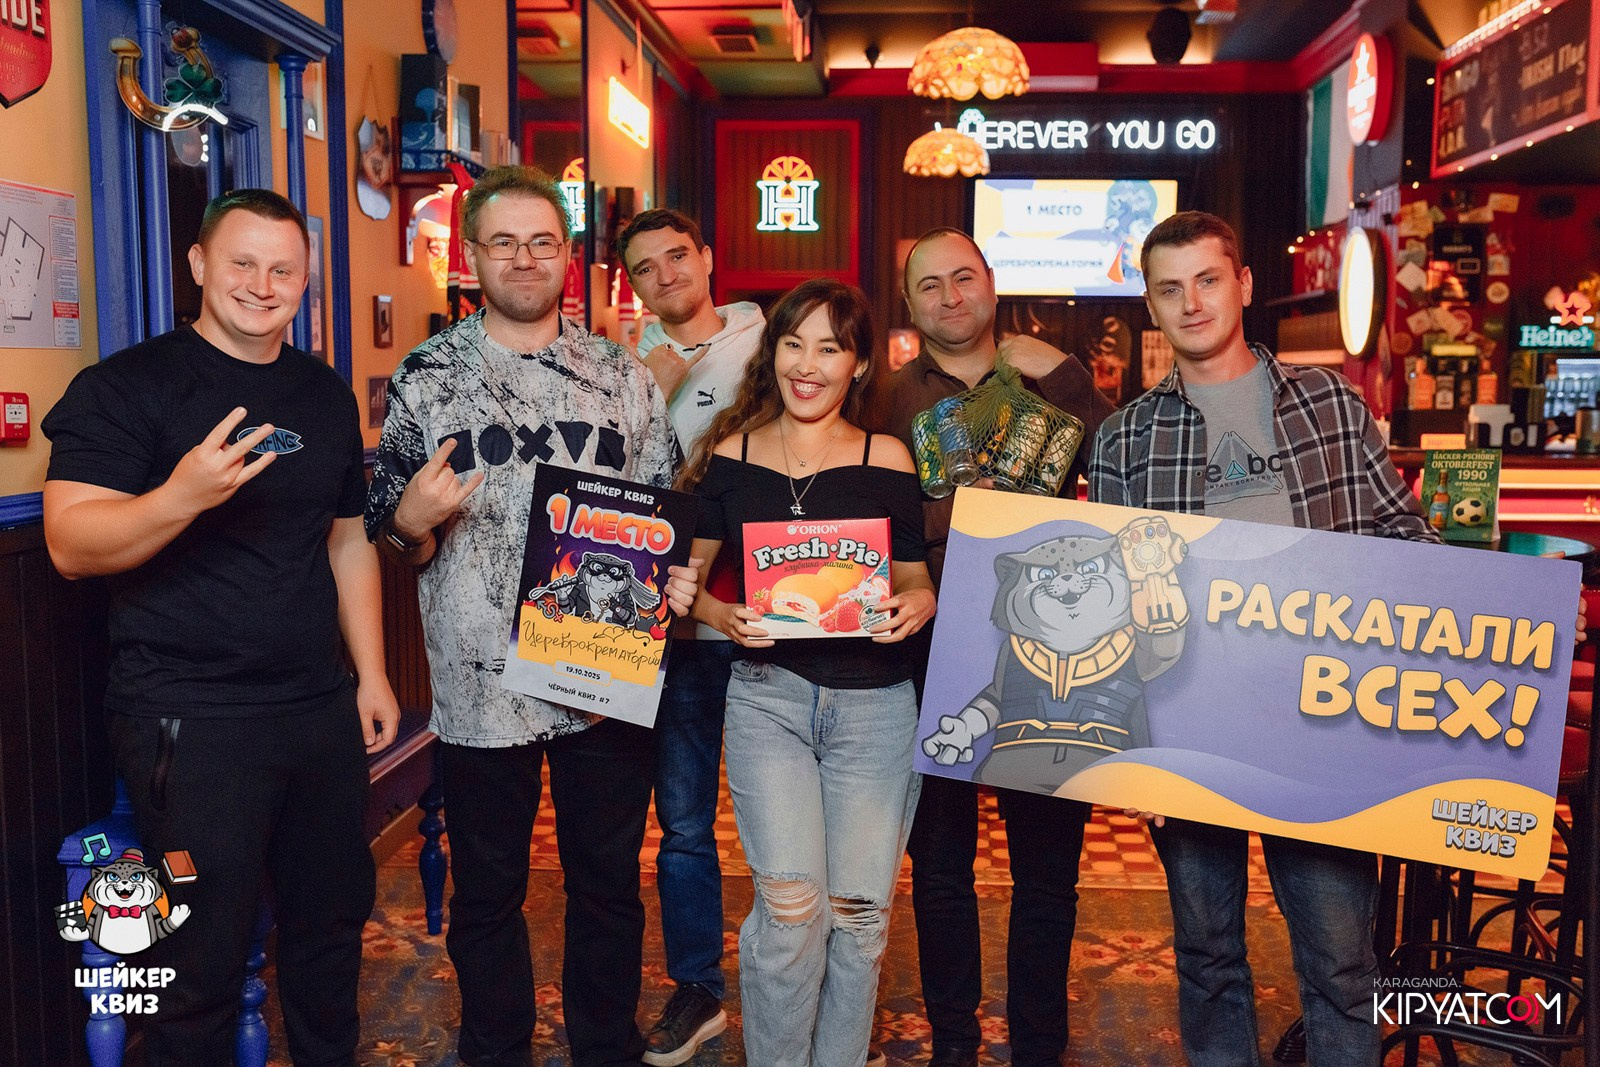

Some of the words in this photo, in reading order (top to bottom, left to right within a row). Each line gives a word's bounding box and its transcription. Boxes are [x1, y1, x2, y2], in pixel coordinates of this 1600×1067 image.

[934, 119, 1088, 150] HEREVER
[1106, 119, 1165, 150] YOU
[1175, 119, 1216, 149] GO
[1027, 205, 1032, 216] 1
[1038, 205, 1083, 216] МЕСТО
[1431, 461, 1495, 469] OKTOBERFEST
[1457, 470, 1488, 481] 1990
[576, 480, 622, 498] ШЕЙКЕР
[624, 489, 655, 505] КВИЗ
[546, 493, 571, 534] 1
[569, 504, 675, 555] МЕСТО
[1206, 578, 1556, 670] РАСКАТАЛИ
[565, 665, 601, 680] 19.10.2025
[548, 681, 577, 697] ЧЁРНЫЙ
[577, 689, 597, 700] КВИЗ
[1299, 654, 1541, 749] ВСЕХ!
[1432, 798, 1538, 834] ШЕЙКЕР
[1446, 825, 1516, 858] КВИЗ
